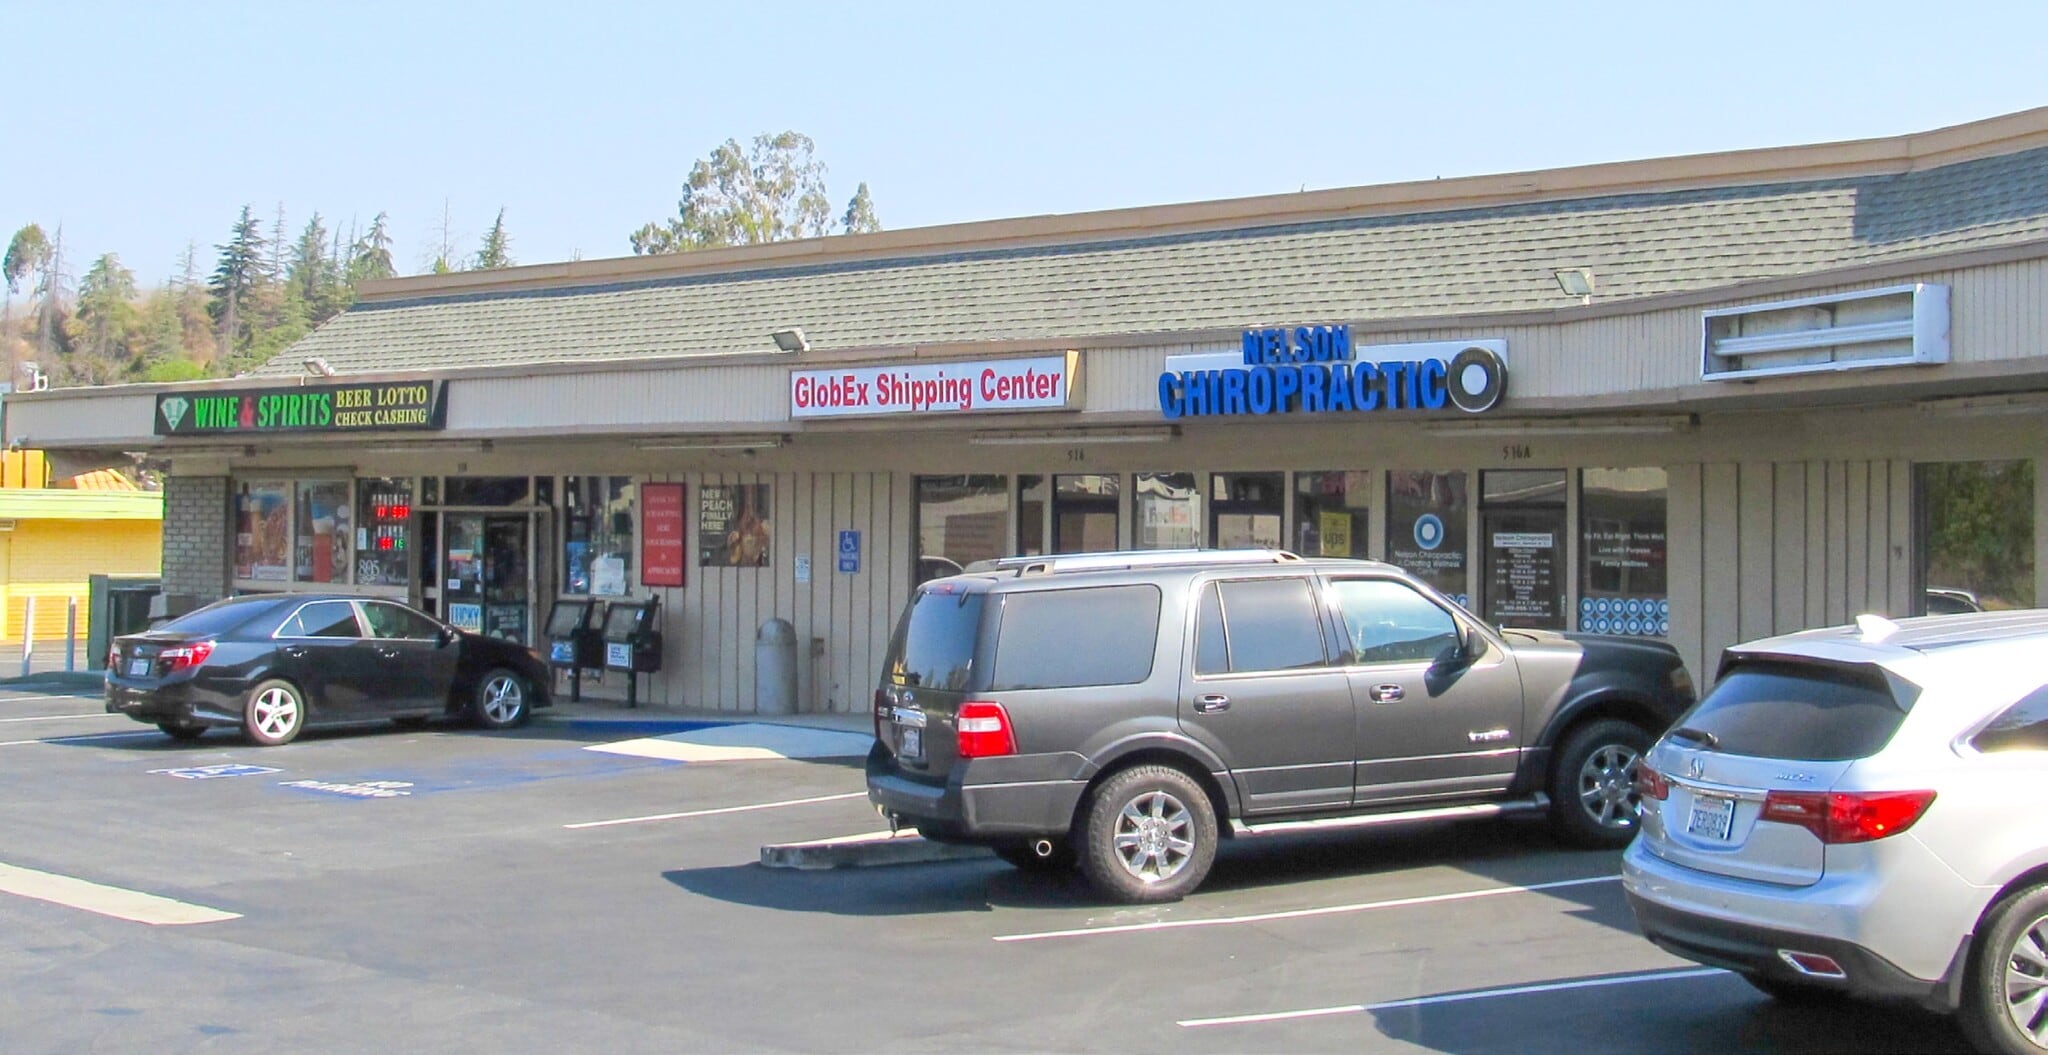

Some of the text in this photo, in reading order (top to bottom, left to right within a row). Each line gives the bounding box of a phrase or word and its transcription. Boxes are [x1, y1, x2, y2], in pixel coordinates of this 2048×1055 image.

[1242, 324, 1353, 364] NELSON
[335, 385, 427, 408] BEER LOTTO
[794, 367, 1061, 411] GlobEx Shipping Center
[1158, 357, 1449, 419] CHIROPRACTIC
[194, 394, 332, 428] WINE & SPIRITS
[335, 407, 427, 427] CHECK CASHING
[701, 488, 721, 499] NEW
[701, 500, 733, 511] PEACH
[701, 511, 733, 521] FINALLY
[701, 521, 725, 530] HERE!
[358, 559, 380, 577] 805
[452, 606, 481, 627] LUCKY
